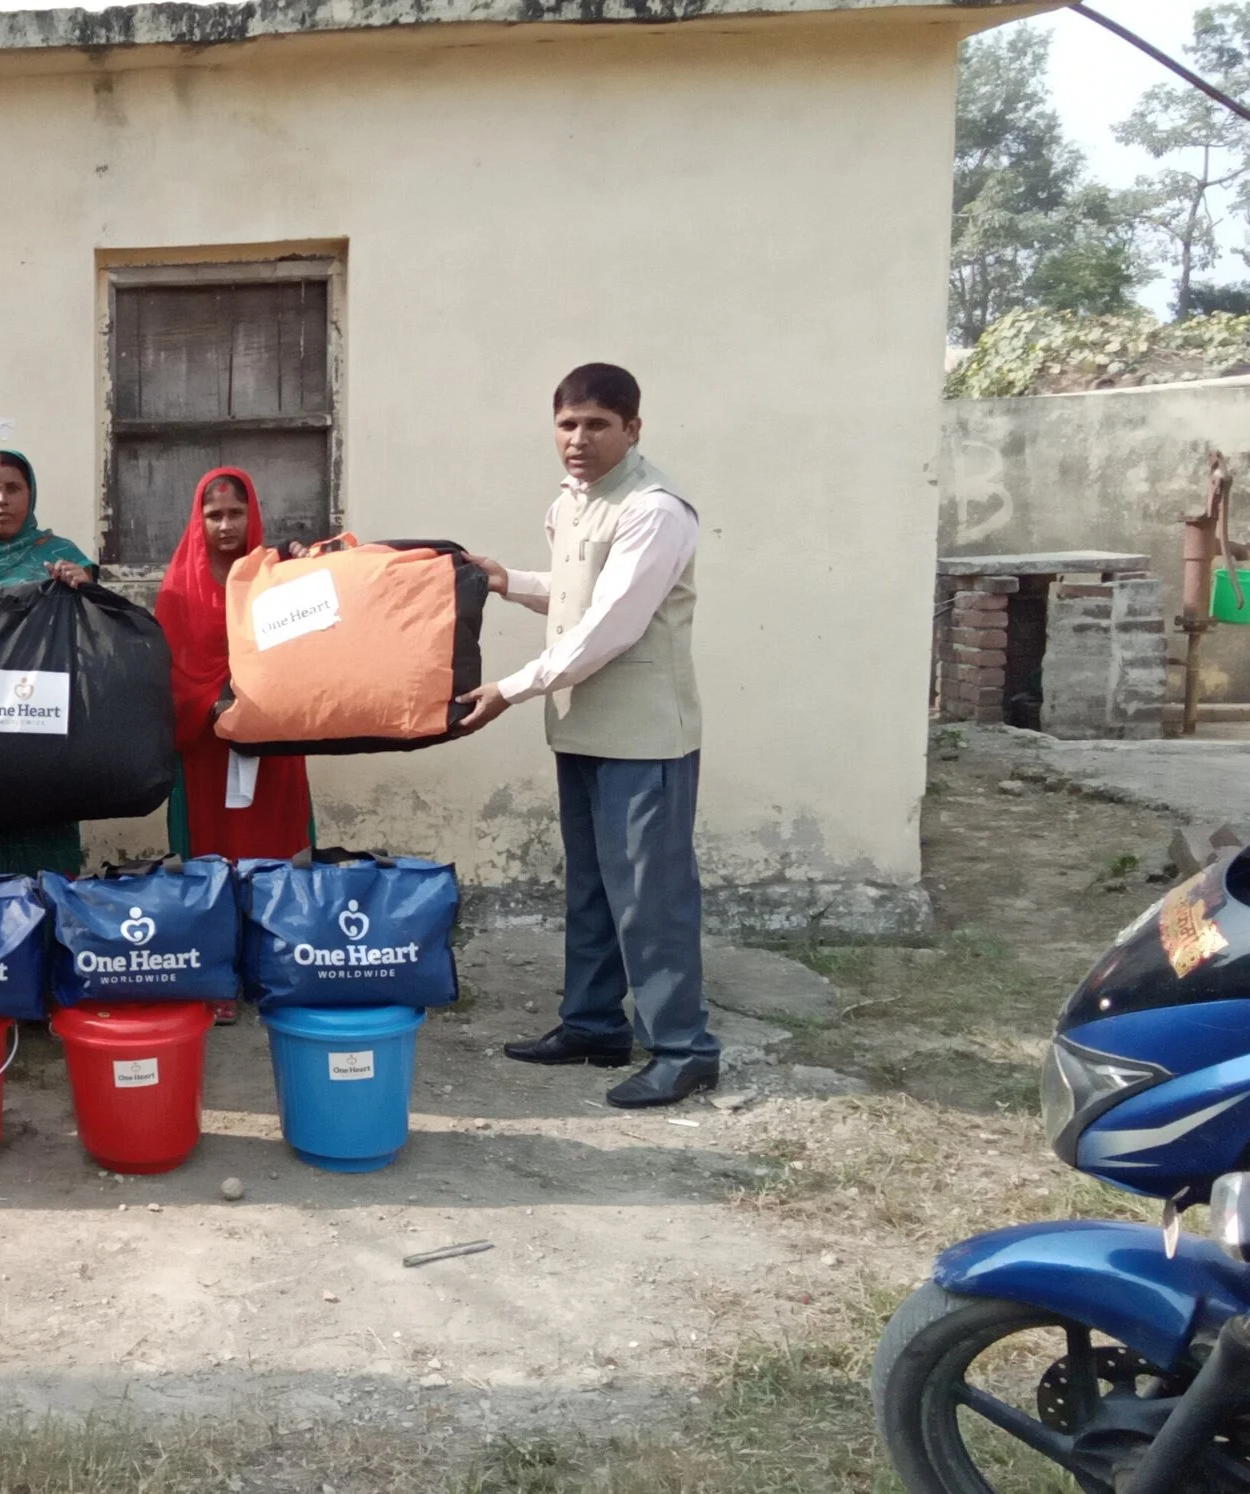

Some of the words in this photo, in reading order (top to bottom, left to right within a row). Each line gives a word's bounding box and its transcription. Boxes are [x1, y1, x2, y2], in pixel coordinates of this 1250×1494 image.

[261, 617, 288, 634] One
[289, 600, 331, 622] Heart
[17, 704, 61, 718] Heart
[293, 943, 345, 966] One
[347, 942, 419, 965] Heart
[77, 950, 126, 973] One
[129, 948, 201, 972] Heart
[100, 973, 177, 984] WORLDWIDE
[317, 968, 396, 979] WORLDWIDE
[333, 1066, 348, 1074] One
[349, 1065, 371, 1073] Heart
[134, 1072, 155, 1081] Heart
